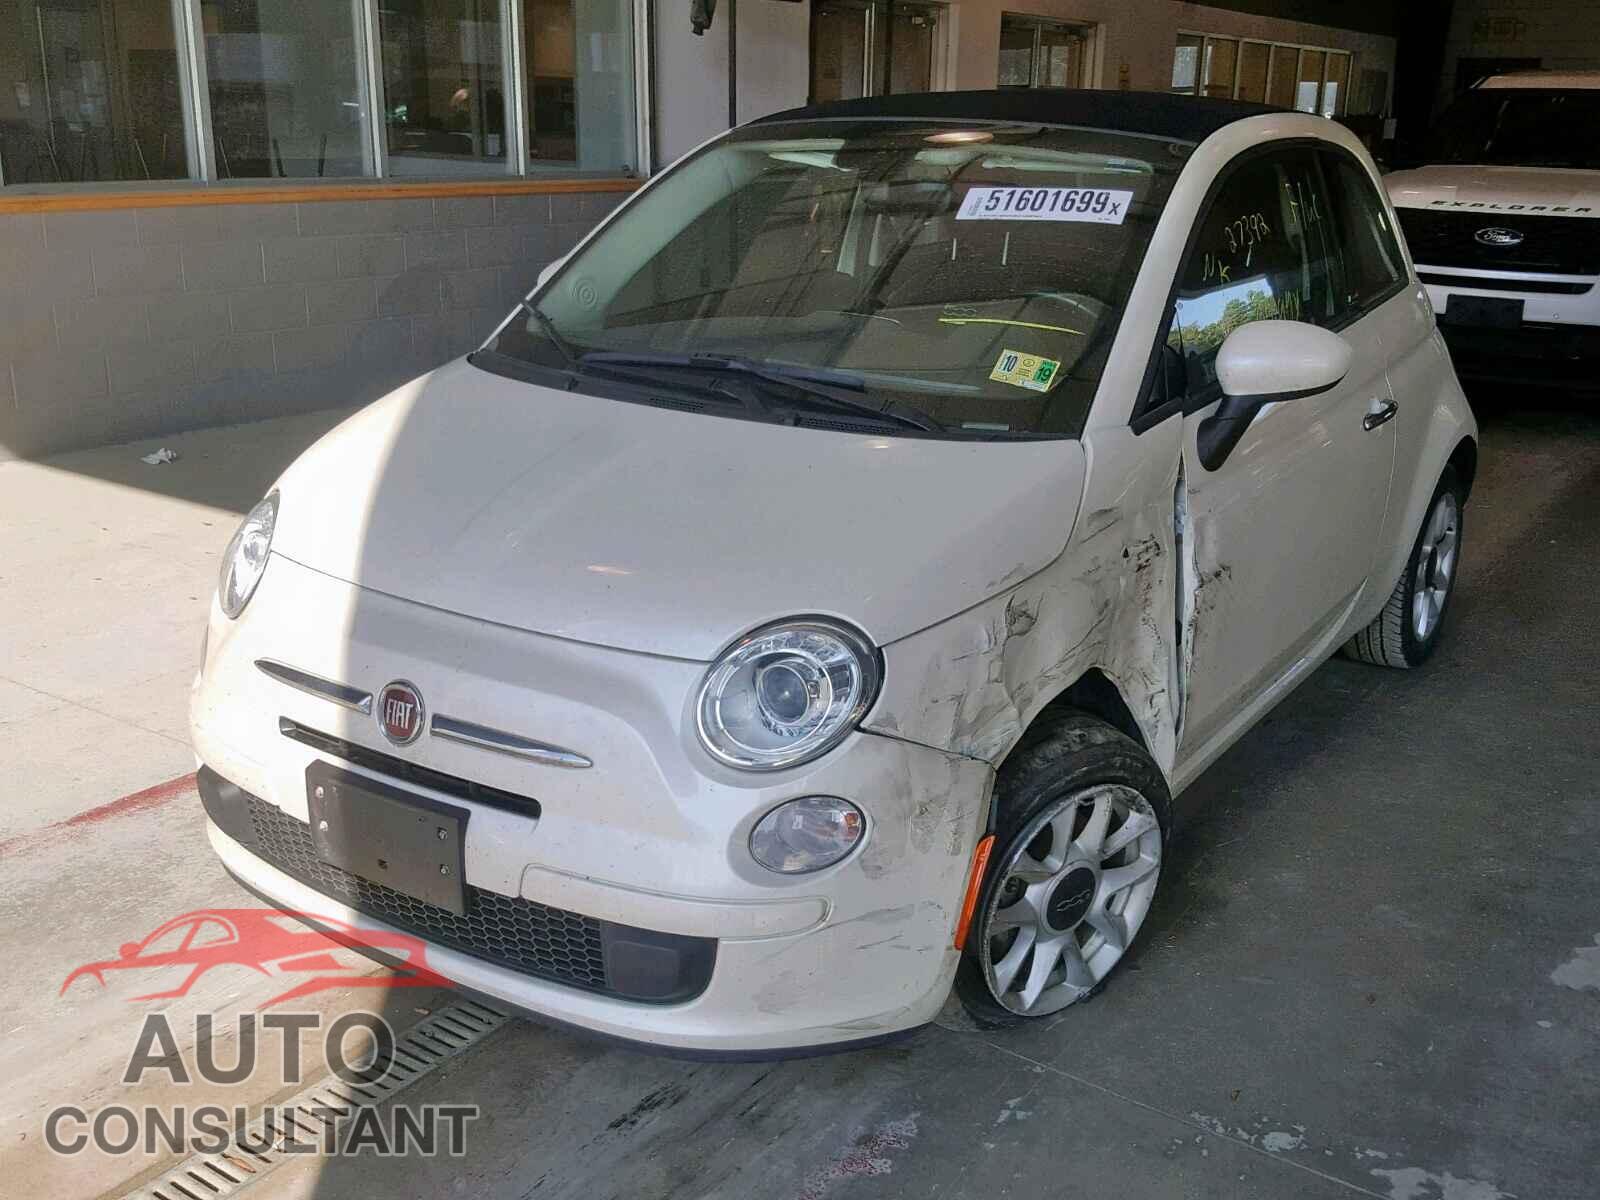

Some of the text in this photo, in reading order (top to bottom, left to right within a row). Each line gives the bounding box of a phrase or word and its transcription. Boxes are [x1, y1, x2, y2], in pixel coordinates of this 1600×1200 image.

[985, 189, 1111, 214] 51601699
[1431, 200, 1592, 213] EXPLORER
[1003, 355, 1018, 372] 10
[1037, 367, 1052, 381] 19
[386, 698, 414, 730] FIAT
